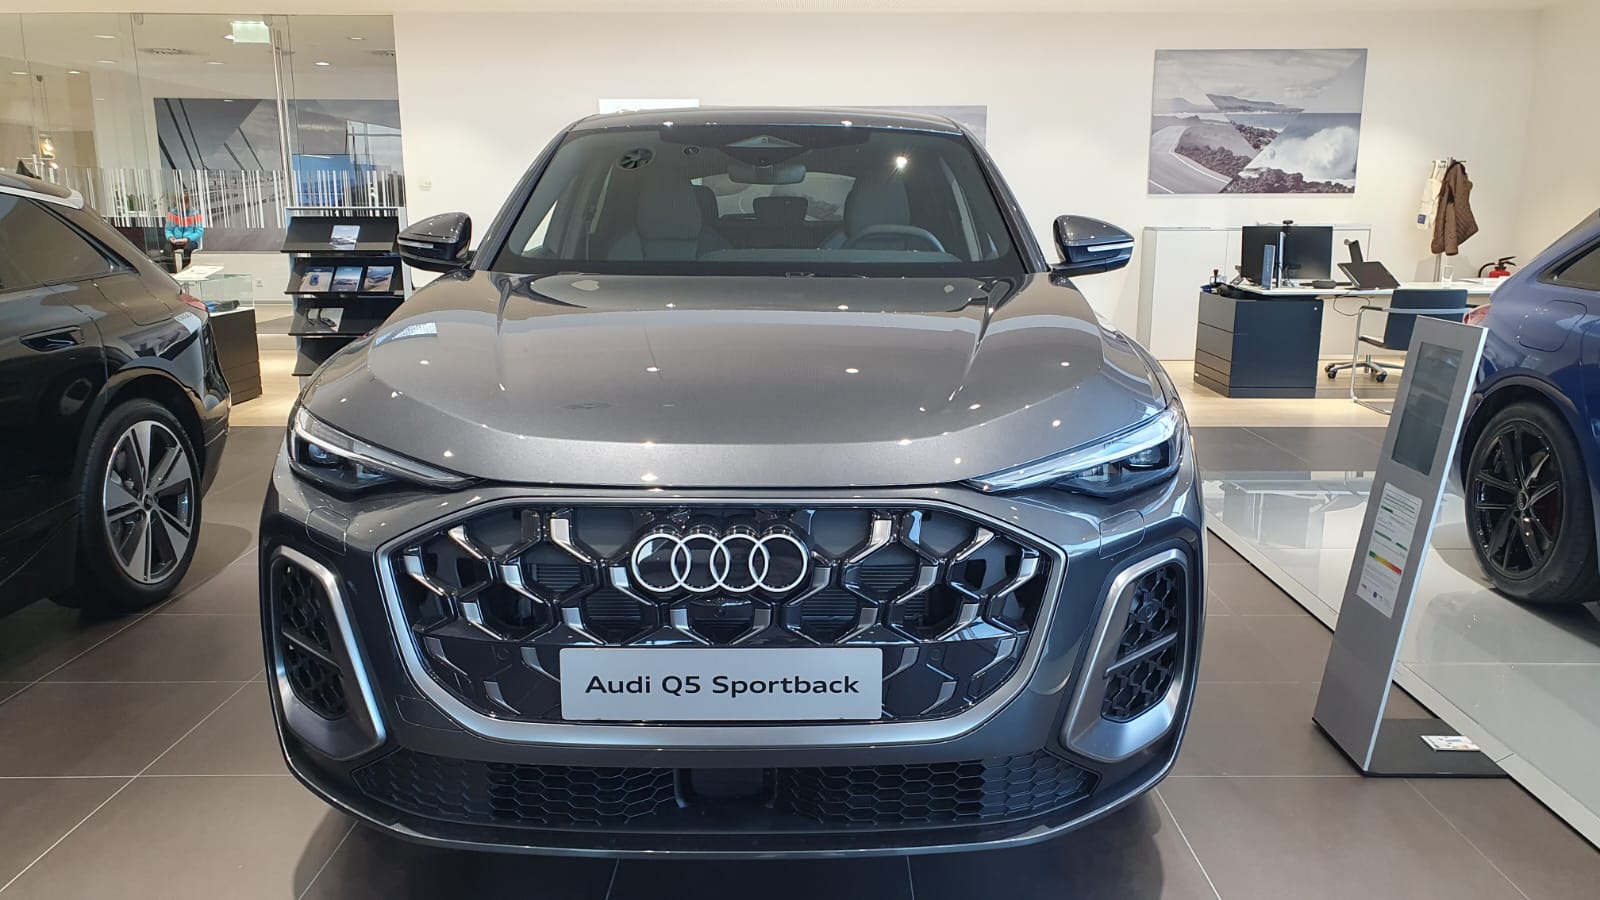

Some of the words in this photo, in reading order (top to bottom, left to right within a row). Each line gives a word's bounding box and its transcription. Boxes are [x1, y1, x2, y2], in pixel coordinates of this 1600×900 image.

[586, 676, 650, 693] Audi
[662, 676, 700, 696] Q5
[713, 676, 858, 698] Sportback
